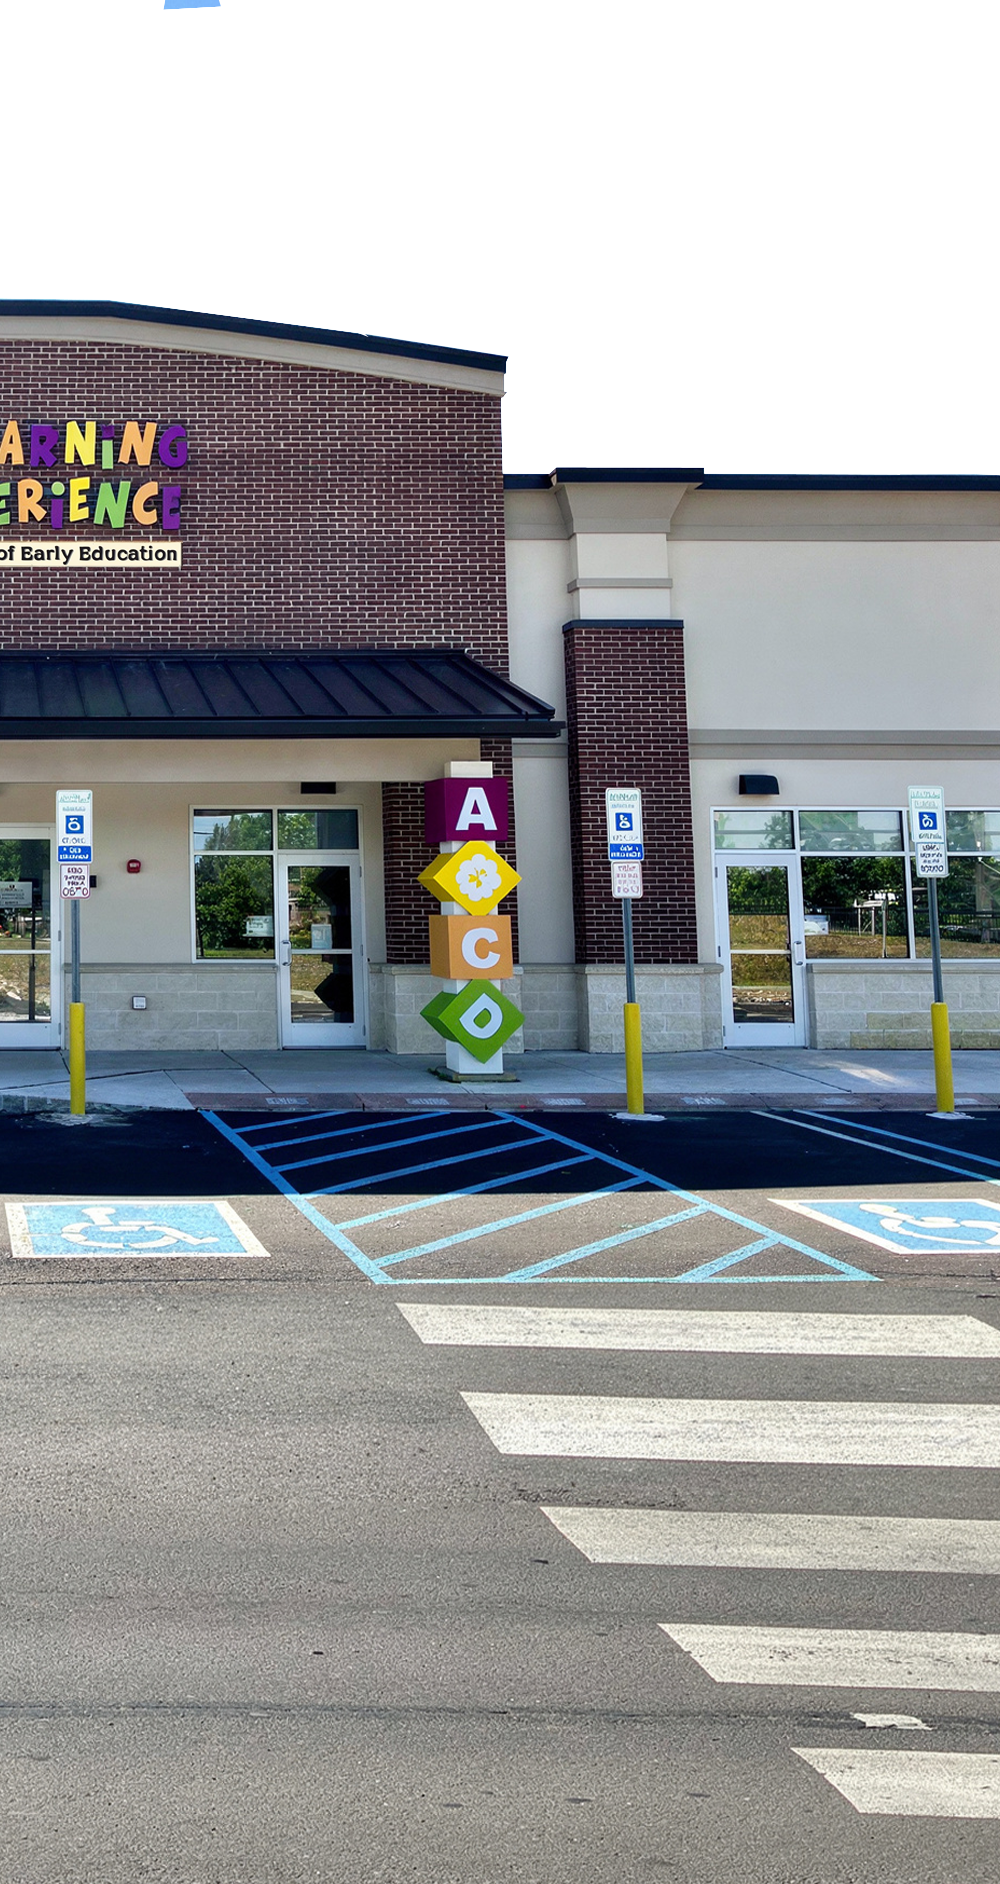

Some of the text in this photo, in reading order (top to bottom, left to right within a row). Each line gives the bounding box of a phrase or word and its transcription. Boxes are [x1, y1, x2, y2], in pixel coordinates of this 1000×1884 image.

[21, 546, 73, 565] Early
[79, 545, 178, 562] Education
[455, 787, 498, 831] A
[461, 927, 501, 969] C
[459, 993, 504, 1039] D
